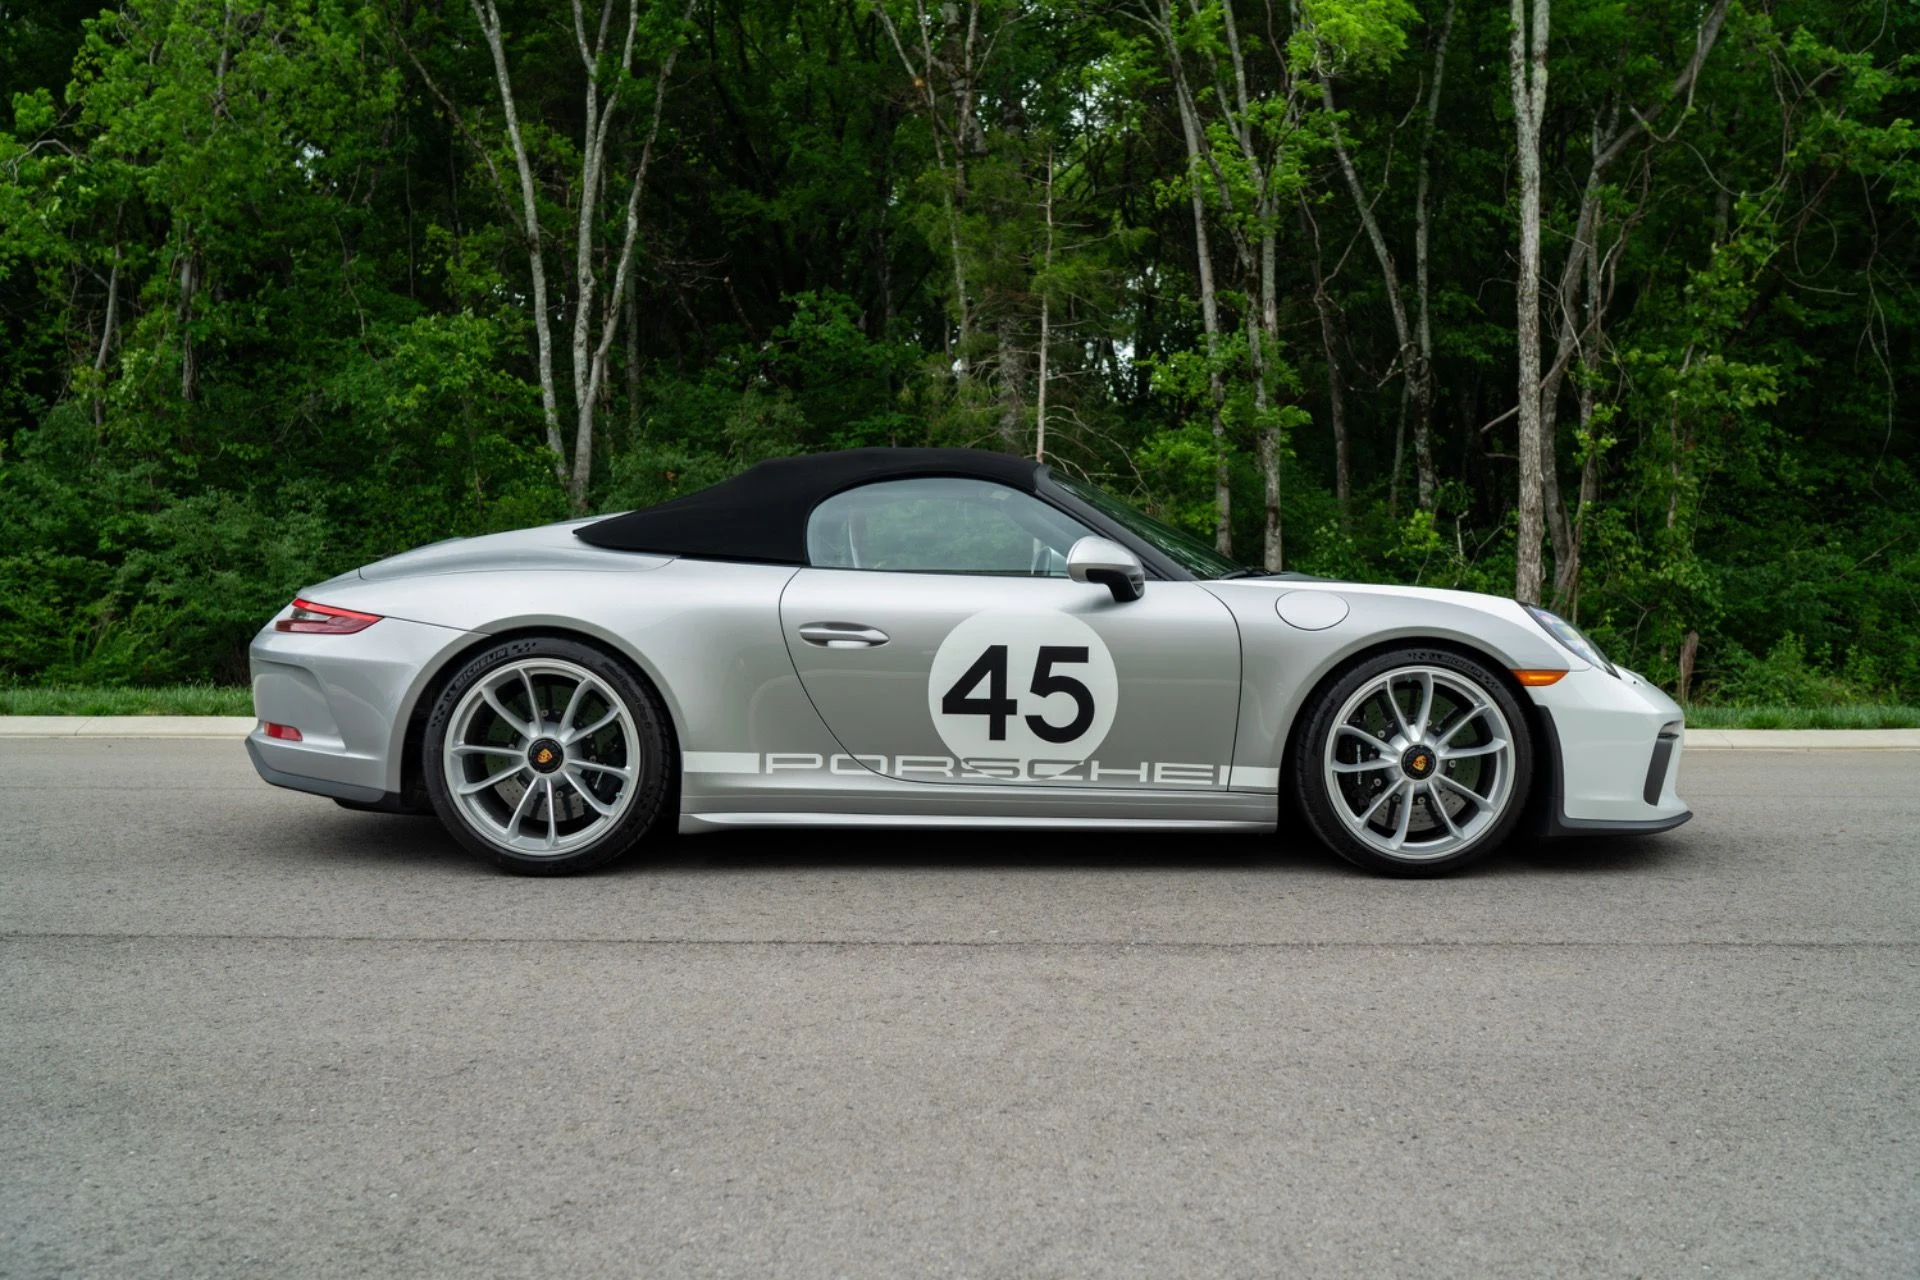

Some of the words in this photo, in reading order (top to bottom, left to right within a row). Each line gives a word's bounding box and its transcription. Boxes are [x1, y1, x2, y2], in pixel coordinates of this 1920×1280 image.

[455, 647, 509, 689] MICHELIN
[942, 645, 1095, 744] 45
[766, 752, 1214, 785] PORSCHE
